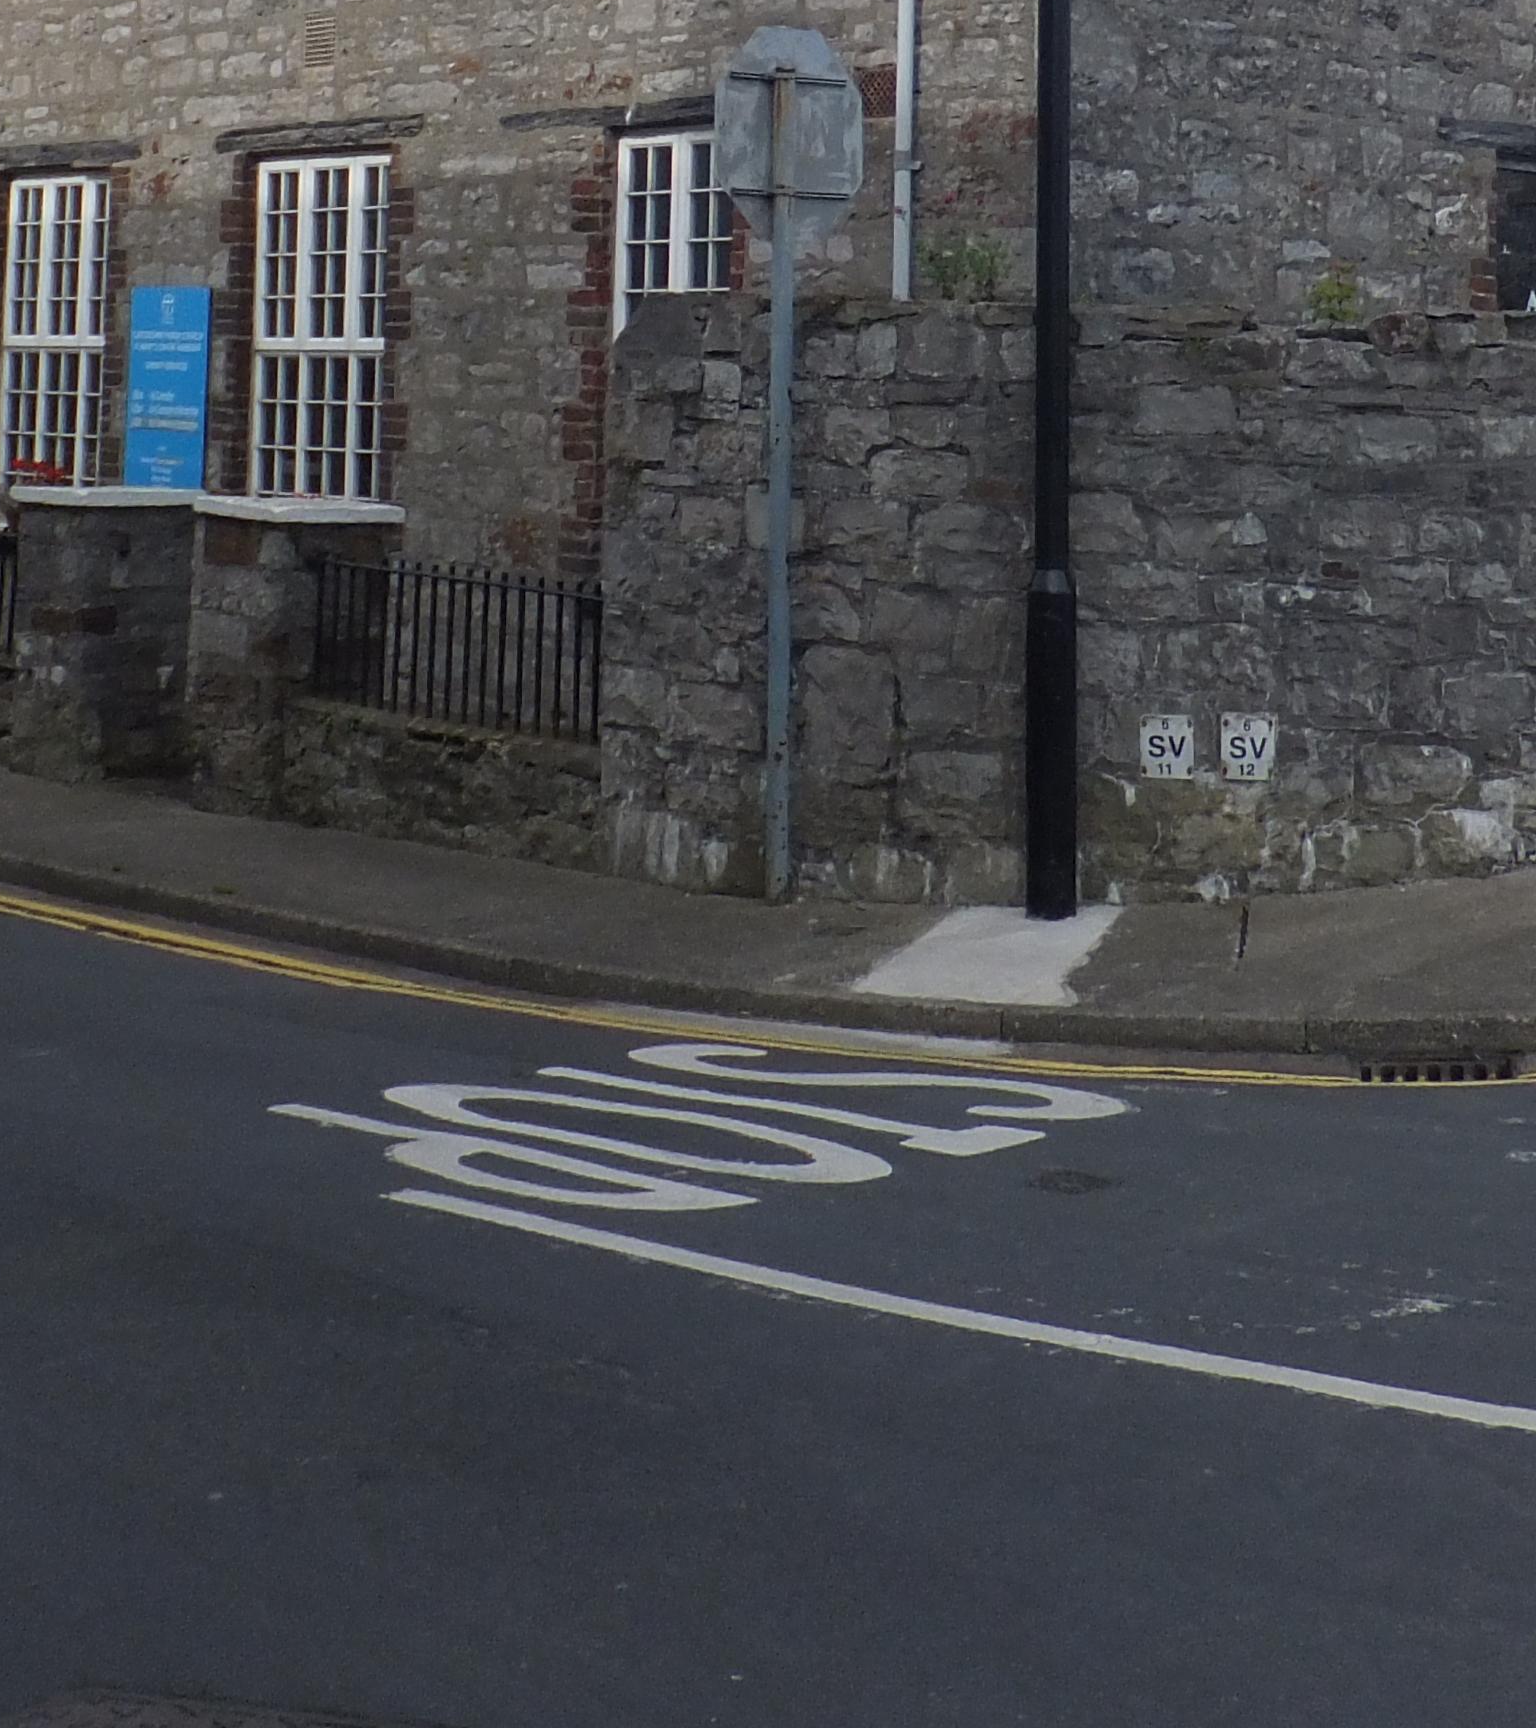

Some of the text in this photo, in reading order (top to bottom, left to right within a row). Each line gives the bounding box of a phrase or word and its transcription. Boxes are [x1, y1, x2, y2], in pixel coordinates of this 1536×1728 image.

[1148, 735, 1186, 758] SV
[1229, 736, 1267, 759] SV
[1158, 763, 1172, 775] 11
[1239, 763, 1255, 777] 12
[267, 1044, 1139, 1210] STOP
